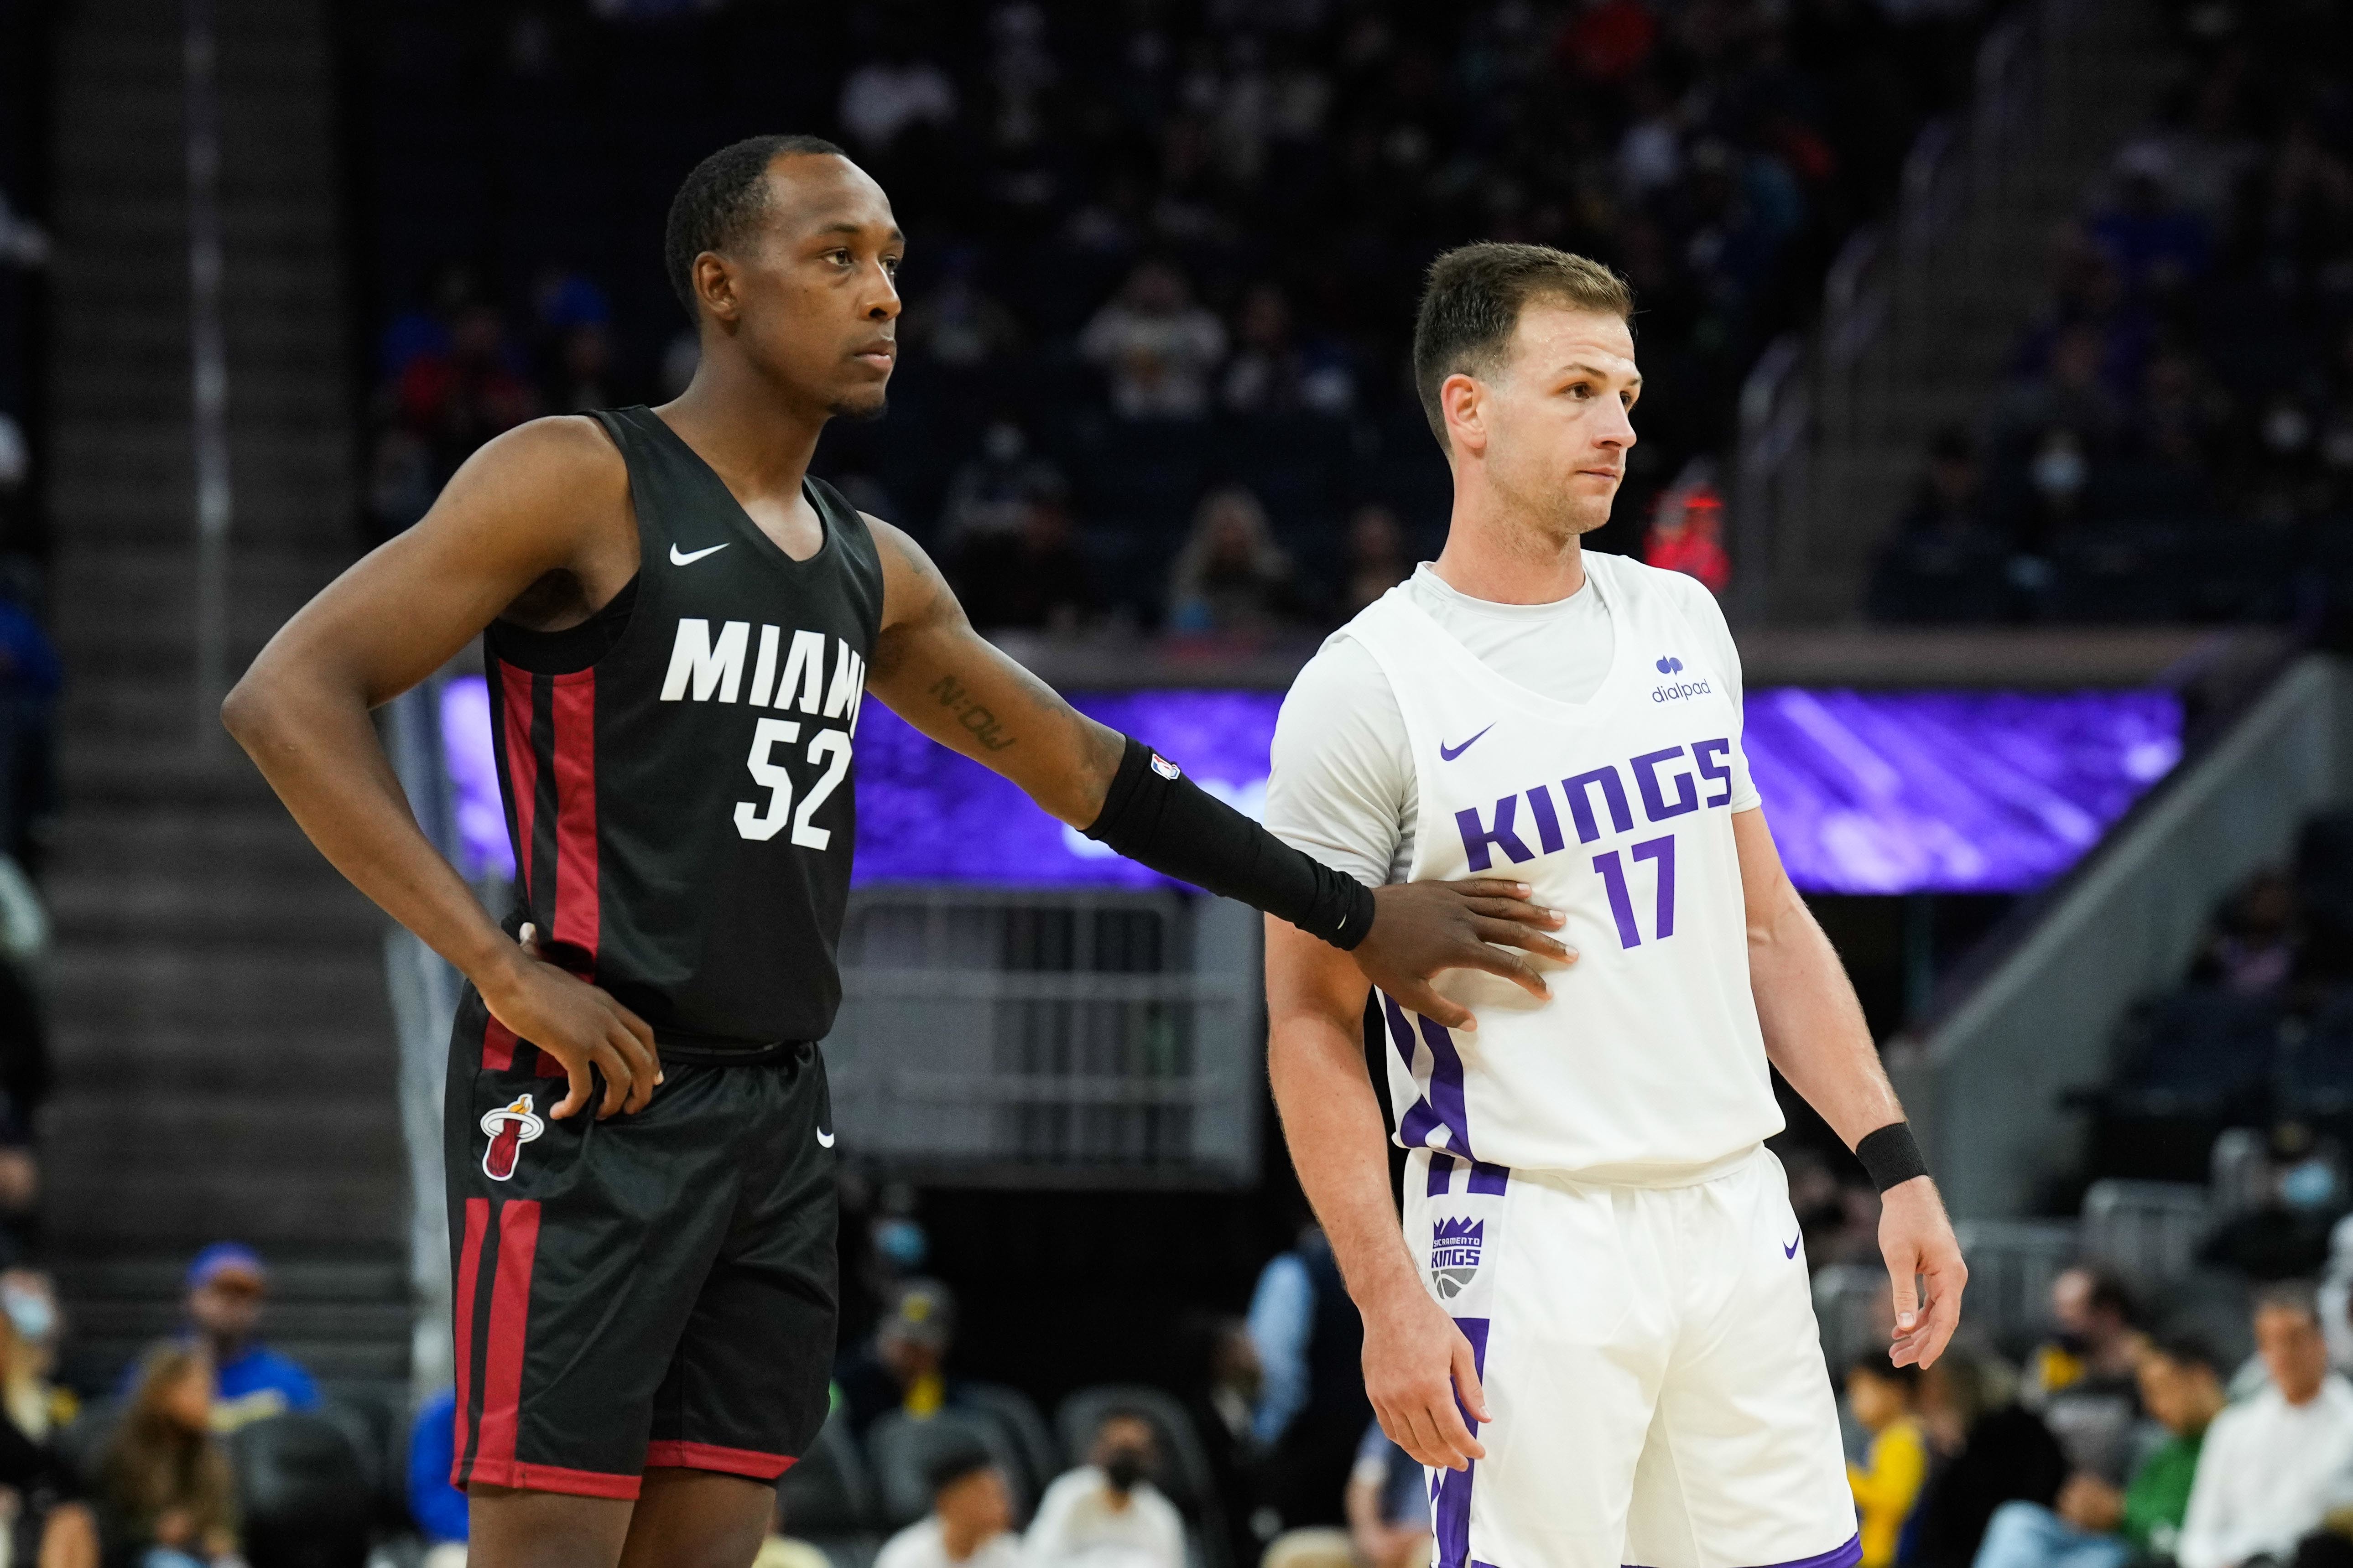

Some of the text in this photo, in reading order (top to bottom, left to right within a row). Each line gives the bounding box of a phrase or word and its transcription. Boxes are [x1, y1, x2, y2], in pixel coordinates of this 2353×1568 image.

[660, 618, 865, 739] MIAMI
[1652, 678, 1711, 702] dialpad
[733, 717, 853, 851] 52
[1455, 738, 1731, 872] KINGS
[1592, 834, 1675, 950] 17
[1432, 1249, 1481, 1268] KINGS
[1433, 1237, 1480, 1247] SACRAMENTO
